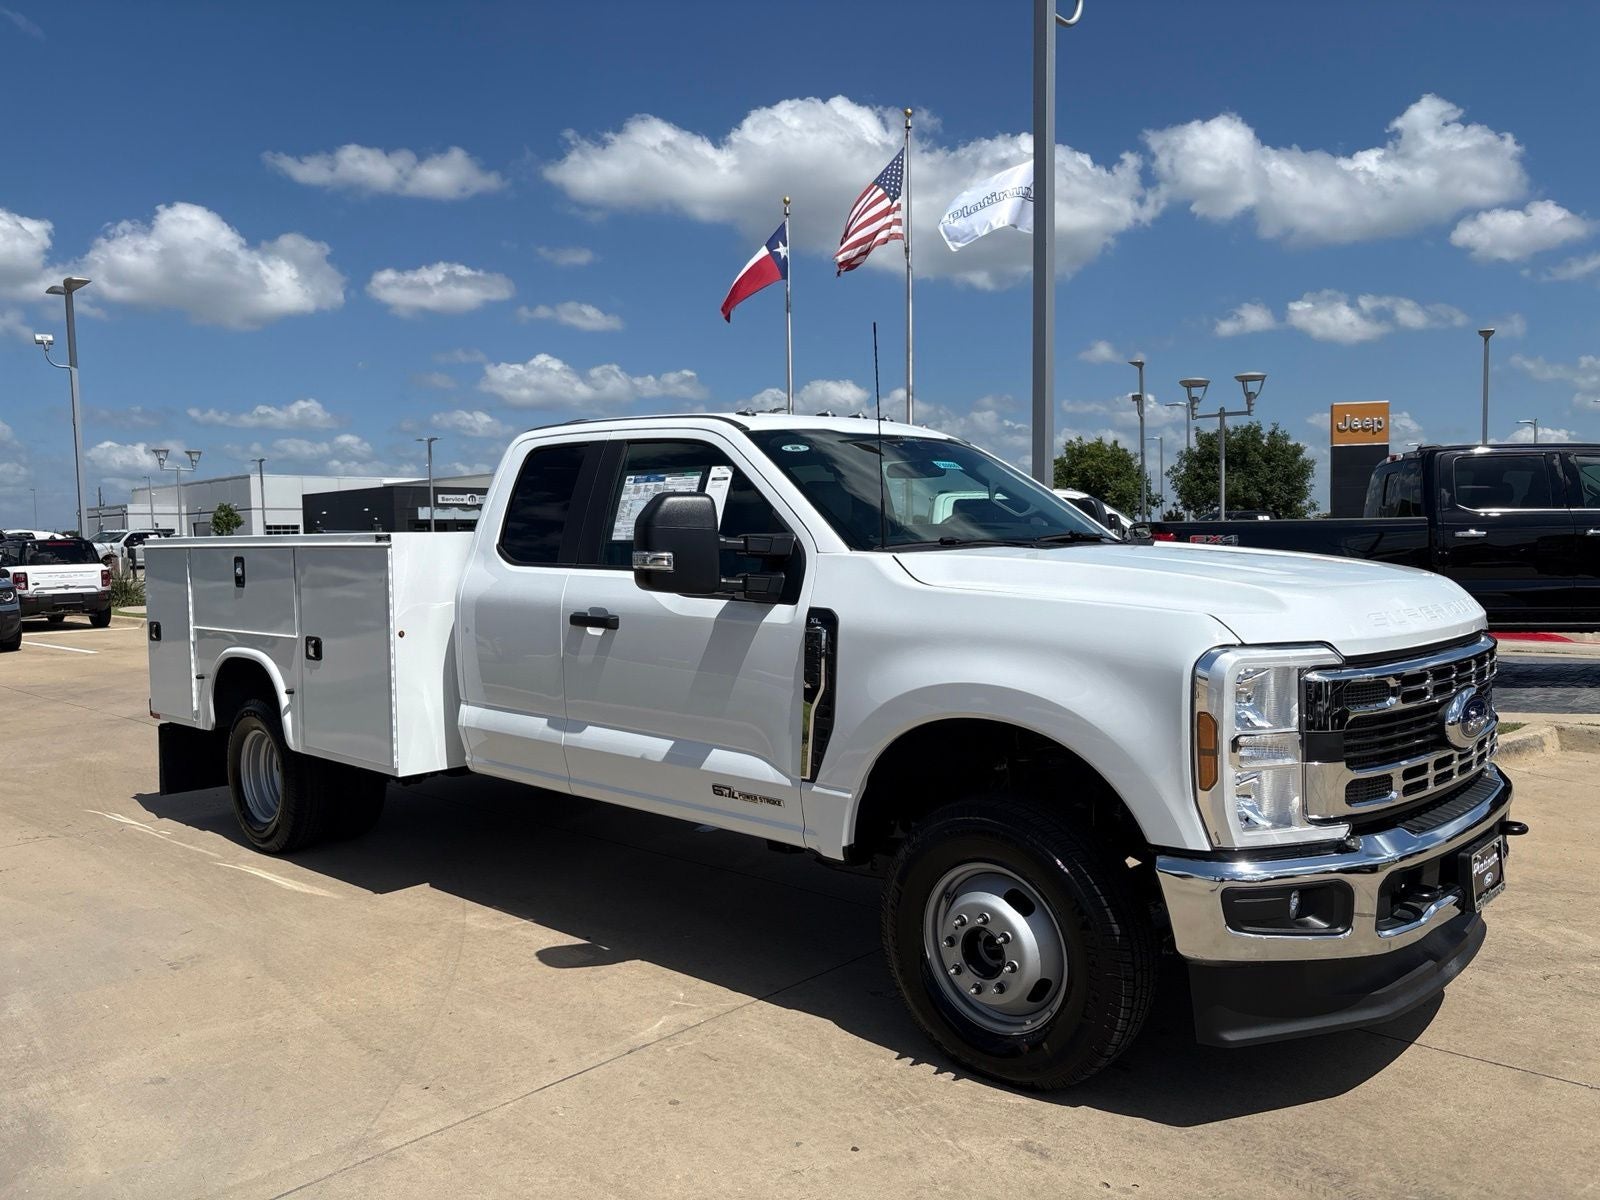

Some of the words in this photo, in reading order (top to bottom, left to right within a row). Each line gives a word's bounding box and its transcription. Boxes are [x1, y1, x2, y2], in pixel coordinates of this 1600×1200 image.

[1337, 414, 1384, 433] Jeep
[712, 784, 738, 799] 6.7L
[738, 792, 758, 803] POWER
[758, 795, 783, 807] STROKE
